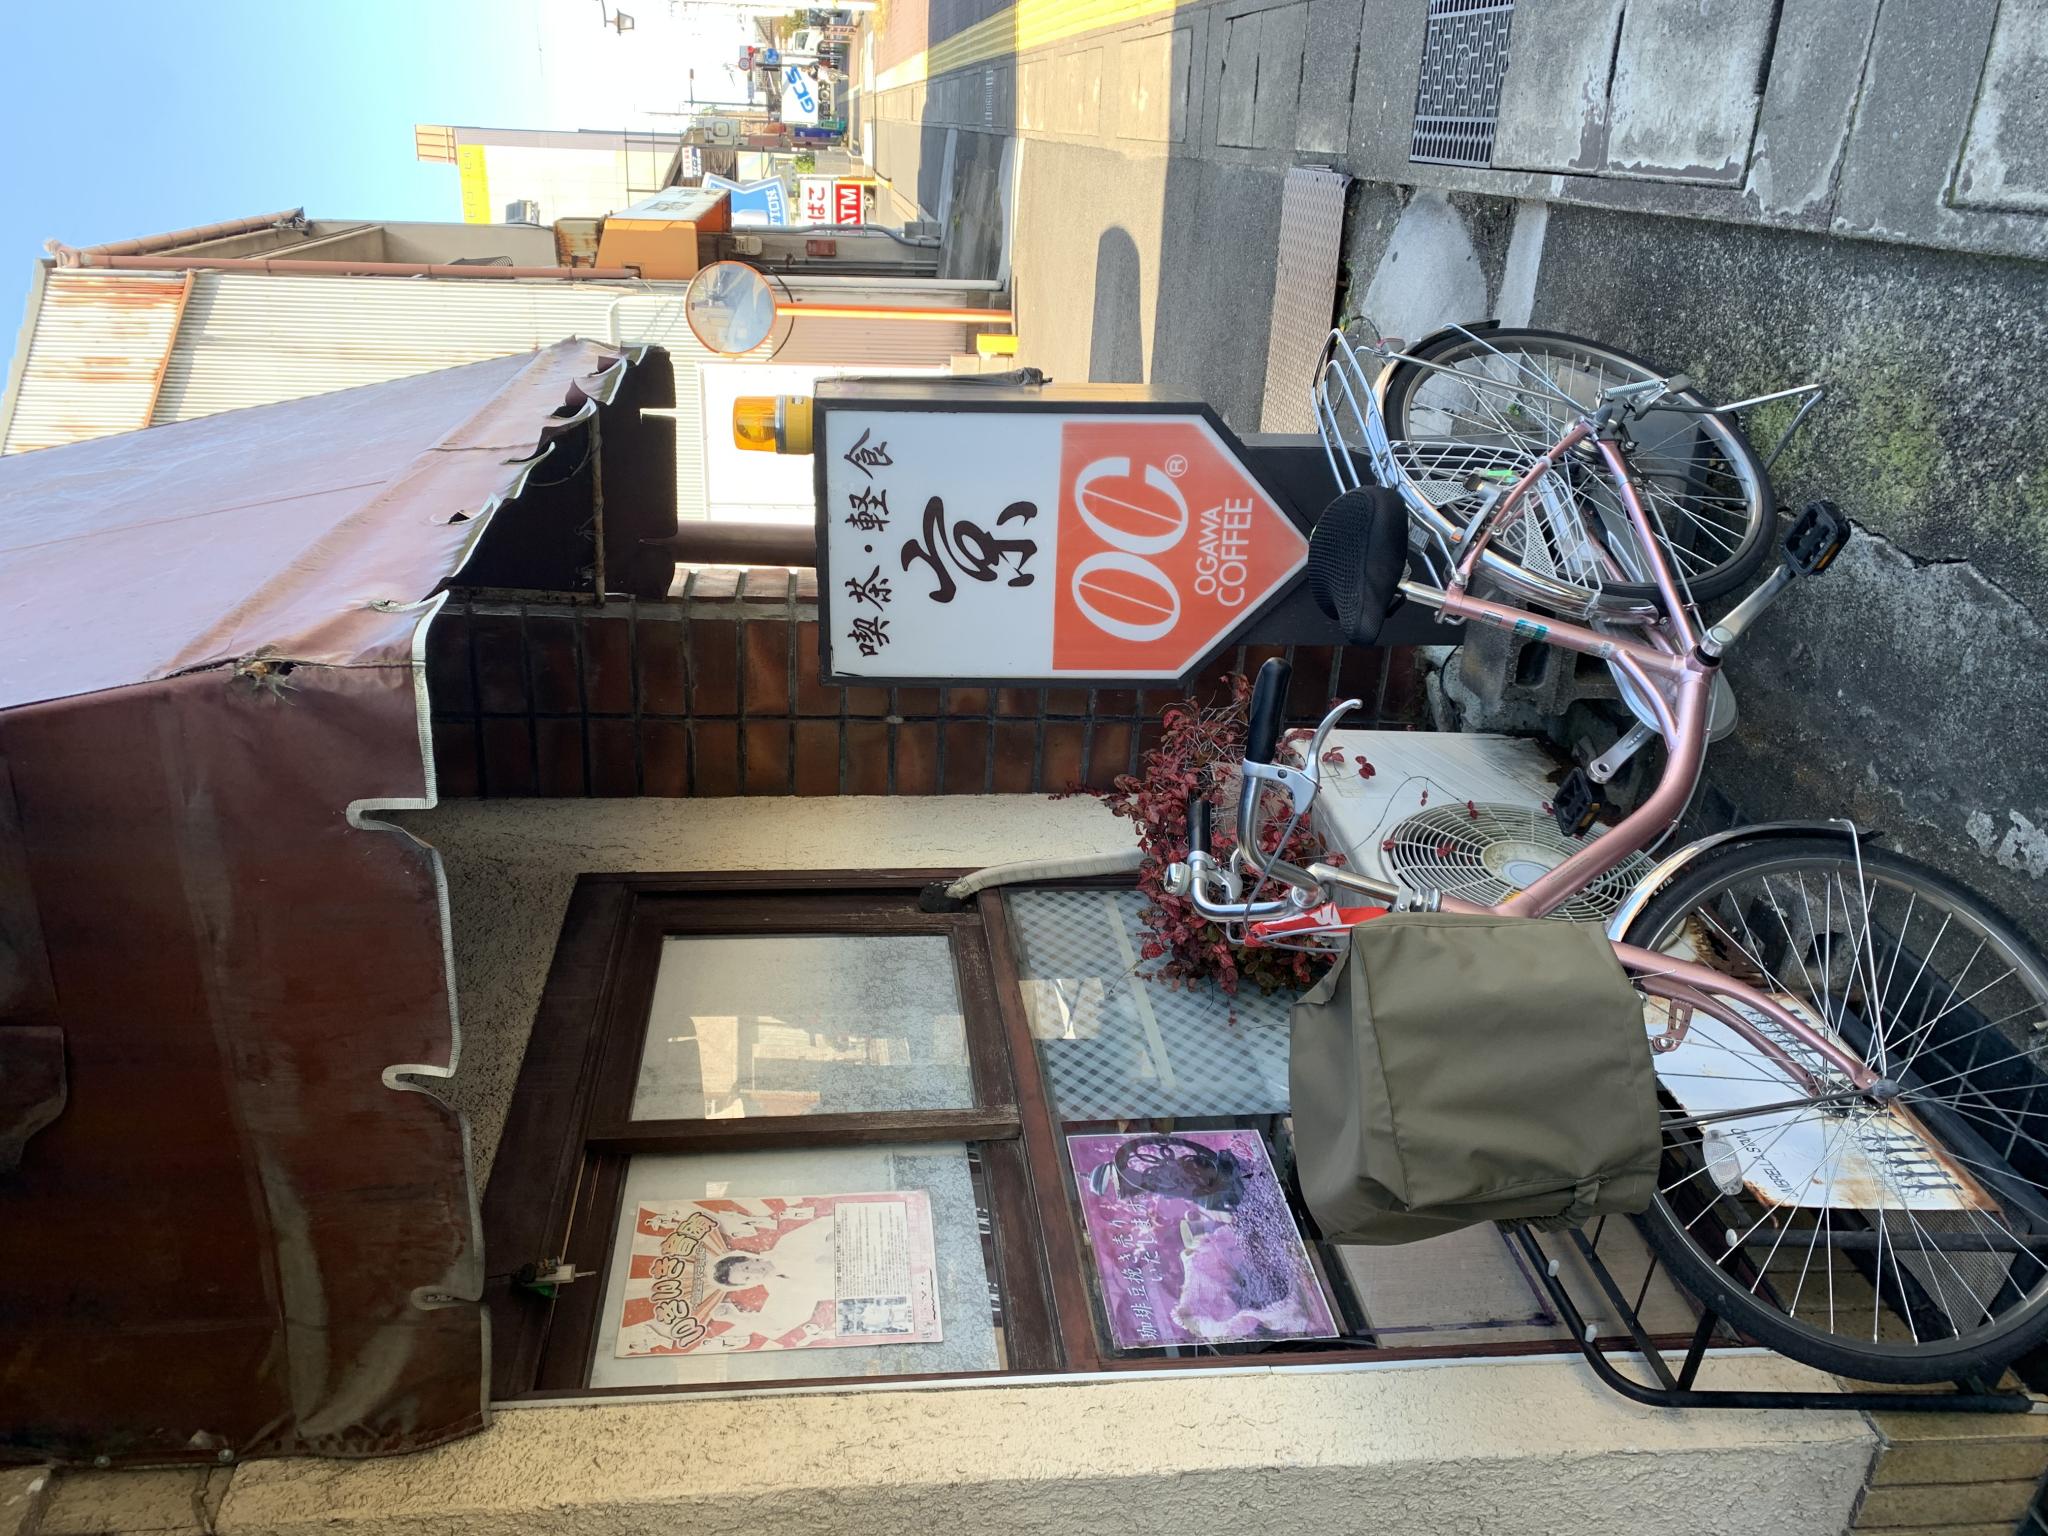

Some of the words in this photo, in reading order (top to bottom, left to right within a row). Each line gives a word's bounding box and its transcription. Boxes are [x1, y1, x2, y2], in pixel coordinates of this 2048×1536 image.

[808, 186, 825, 224] ばこ
[840, 188, 857, 224] ATM
[843, 427, 894, 657] 喫茶・軽食
[900, 495, 1038, 604] 京
[1194, 505, 1223, 596] OGAWA
[1217, 497, 1254, 606] COFFEE
[1730, 1128, 1762, 1153] STAND
[1753, 1154, 1800, 1198] UMBRELLA
[1108, 1219, 1160, 1340] 珈琲豆挽き売り
